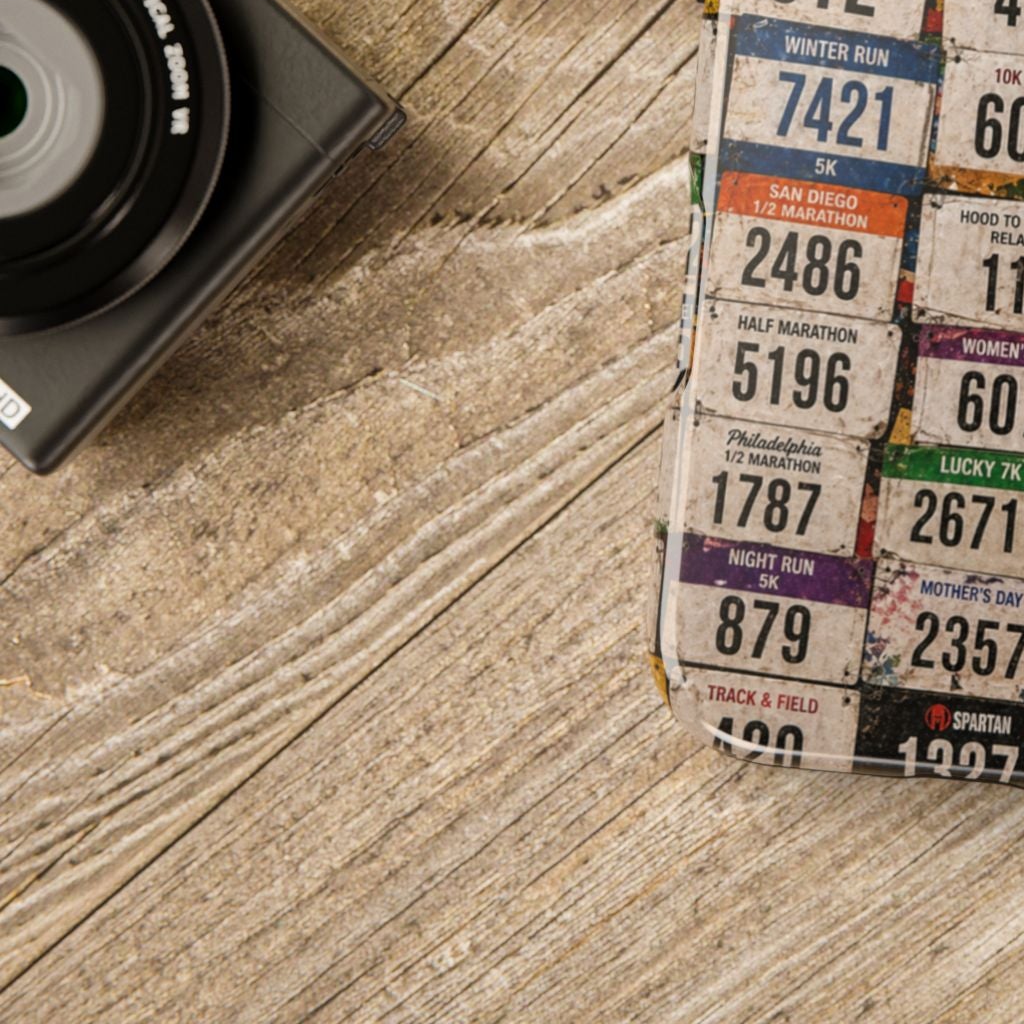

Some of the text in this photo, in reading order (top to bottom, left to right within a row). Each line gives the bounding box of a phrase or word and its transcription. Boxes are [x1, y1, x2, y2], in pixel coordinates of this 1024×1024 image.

[785, 35, 889, 67] WINTER RUN
[163, 42, 190, 100] ZOOM
[995, 68, 1022, 86] 10K
[776, 71, 893, 151] 7421
[815, 158, 838, 176] 5K
[769, 183, 858, 210] SAN DIEGO
[753, 200, 868, 229] 1/2 MARATHON
[960, 210, 999, 226] HOOD
[1004, 214, 1021, 229] TO
[741, 226, 862, 301] 2486
[737, 315, 858, 344] HALF MARATHON
[732, 341, 851, 413] 5196
[727, 429, 823, 457] Philadelphia
[725, 450, 821, 474] 1/2 MARATHON
[940, 456, 1022, 481] LUCKY 7K
[712, 471, 821, 536] 1787
[910, 489, 1018, 553] 2671
[728, 548, 815, 576] NIGHT RUN
[758, 574, 780, 589] 5K
[920, 579, 992, 603] MOTHER'S
[996, 590, 1024, 607] DAY
[715, 595, 811, 664] 879
[707, 684, 818, 714] TRACK & FIELD
[952, 711, 1012, 735] SPARTAN
